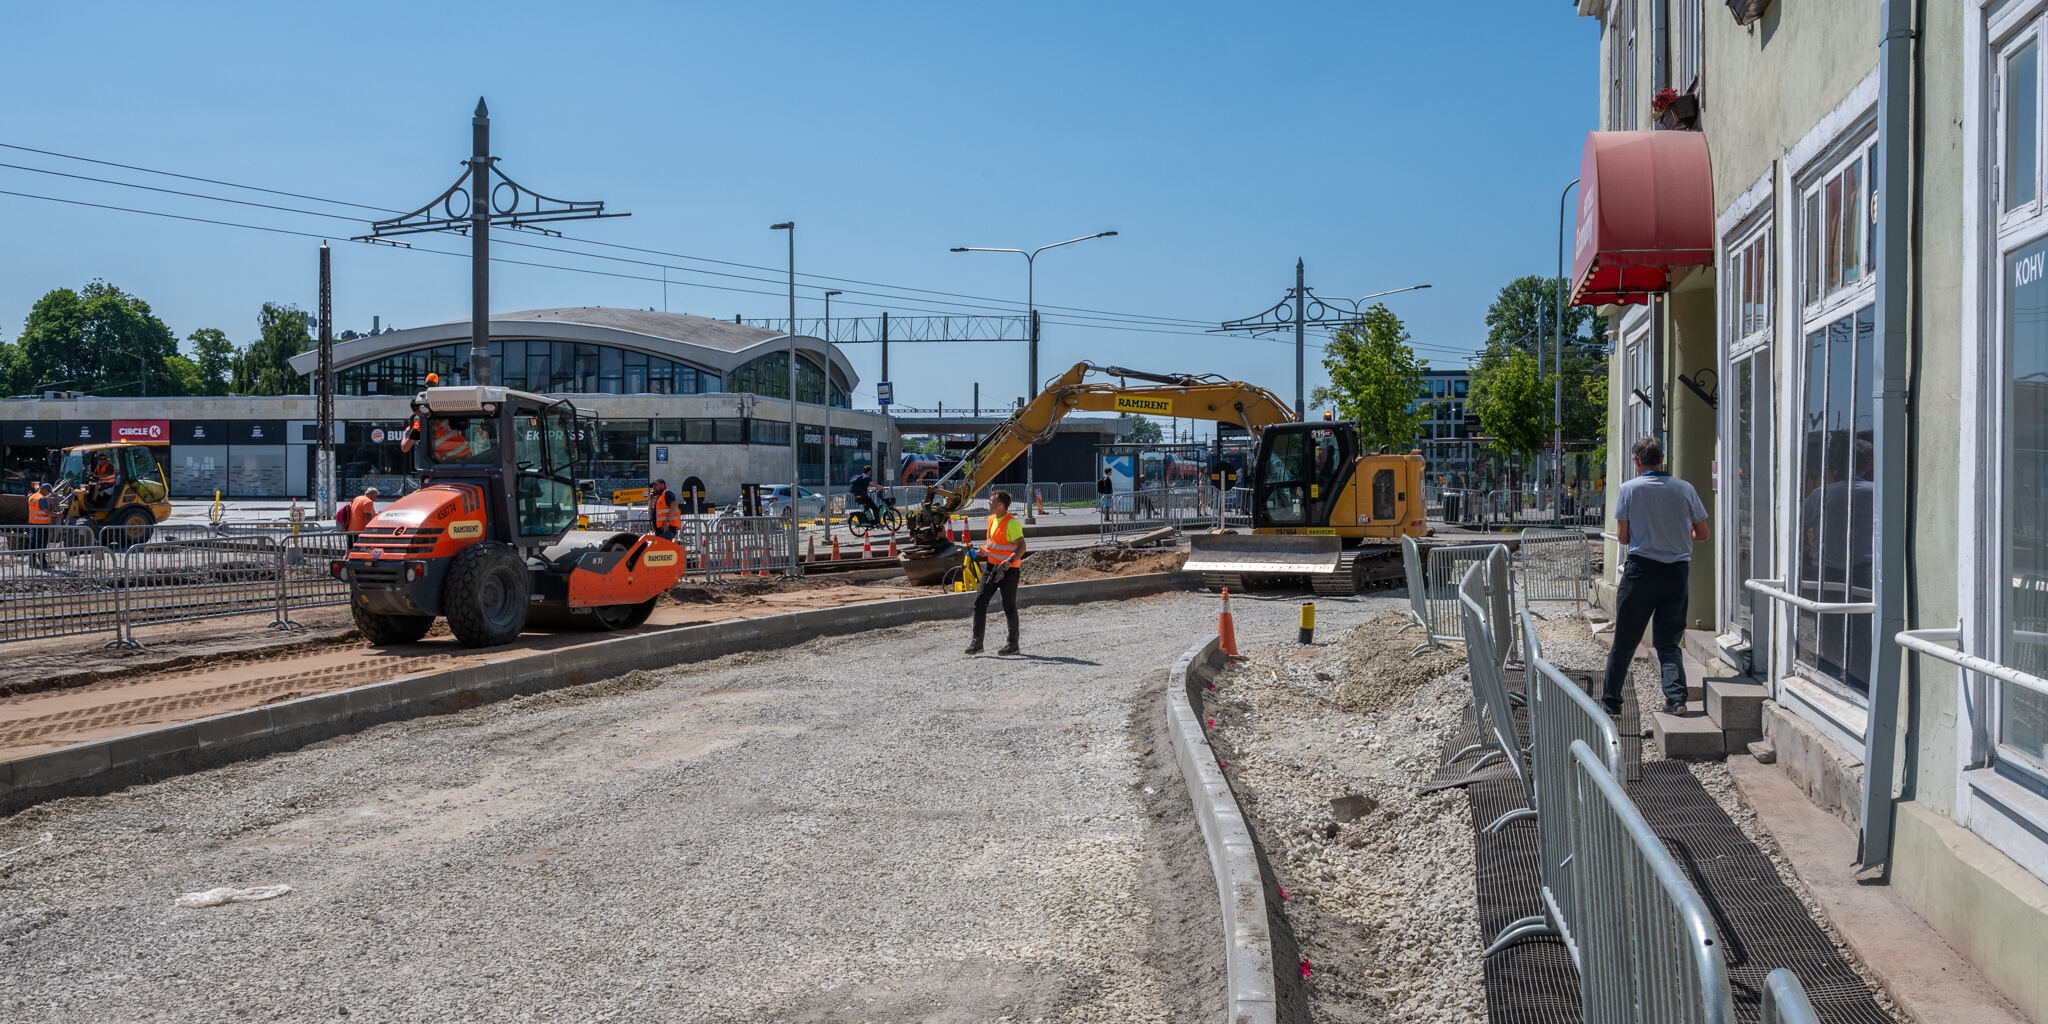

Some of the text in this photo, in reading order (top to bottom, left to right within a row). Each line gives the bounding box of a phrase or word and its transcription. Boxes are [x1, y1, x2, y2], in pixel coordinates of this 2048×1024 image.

[2015, 250, 2046, 288] KOHV
[1118, 398, 1169, 410] RAMIRENT
[119, 425, 161, 438] CIRCLE K
[387, 430, 404, 441] BU
[526, 430, 585, 441] EKPRSS
[453, 525, 479, 533] RAMIRENT
[647, 554, 673, 562] RAMIRENT
